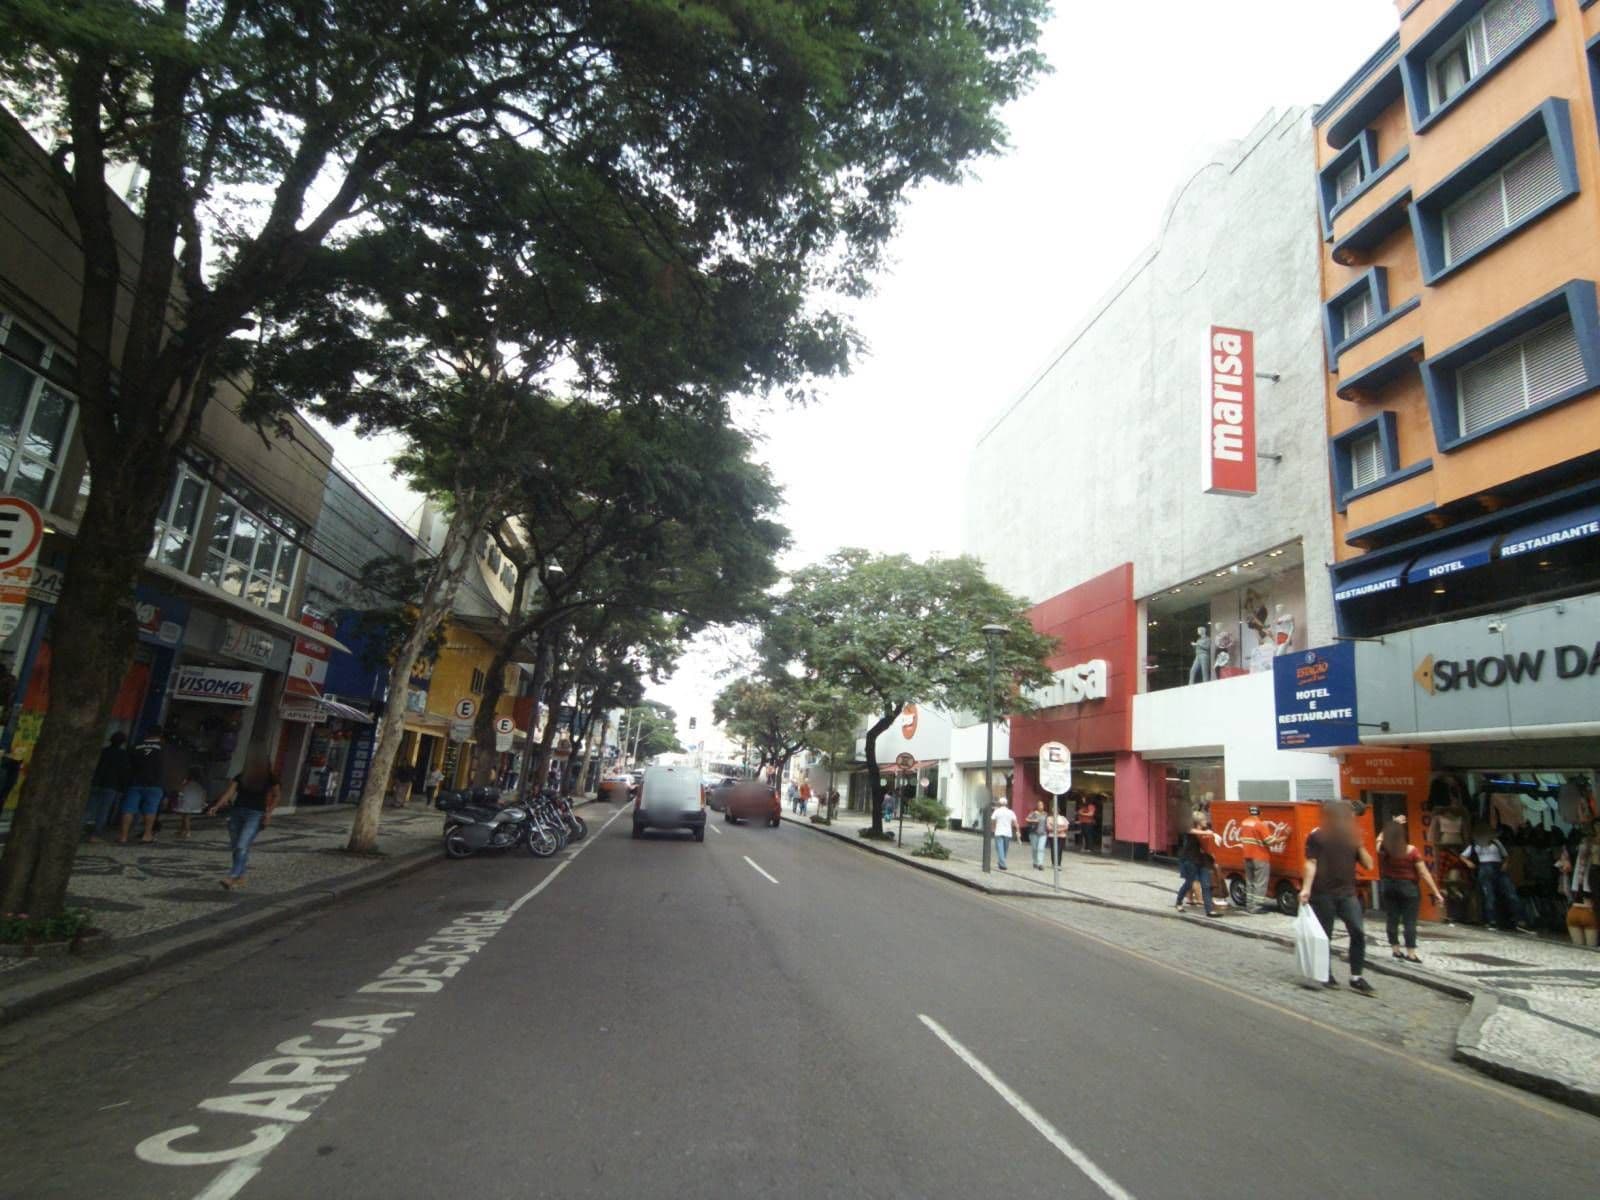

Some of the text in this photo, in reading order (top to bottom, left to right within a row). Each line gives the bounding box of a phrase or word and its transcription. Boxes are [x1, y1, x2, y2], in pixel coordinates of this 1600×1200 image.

[1213, 332, 1243, 462] marisa
[1501, 521, 1600, 557] RESTAURANTE
[1428, 560, 1465, 577] HOTEL
[1335, 577, 1399, 601] RESTAURANTE
[1433, 649, 1546, 692] SHOW
[1295, 688, 1330, 700] HOTEL
[461, 702, 470, 716] E
[1309, 700, 1317, 710] E
[501, 719, 509, 731] E
[1278, 708, 1353, 724] RESTAURANTE
[357, 908, 512, 993] DESCARGA
[134, 1010, 416, 1167] CARGA
